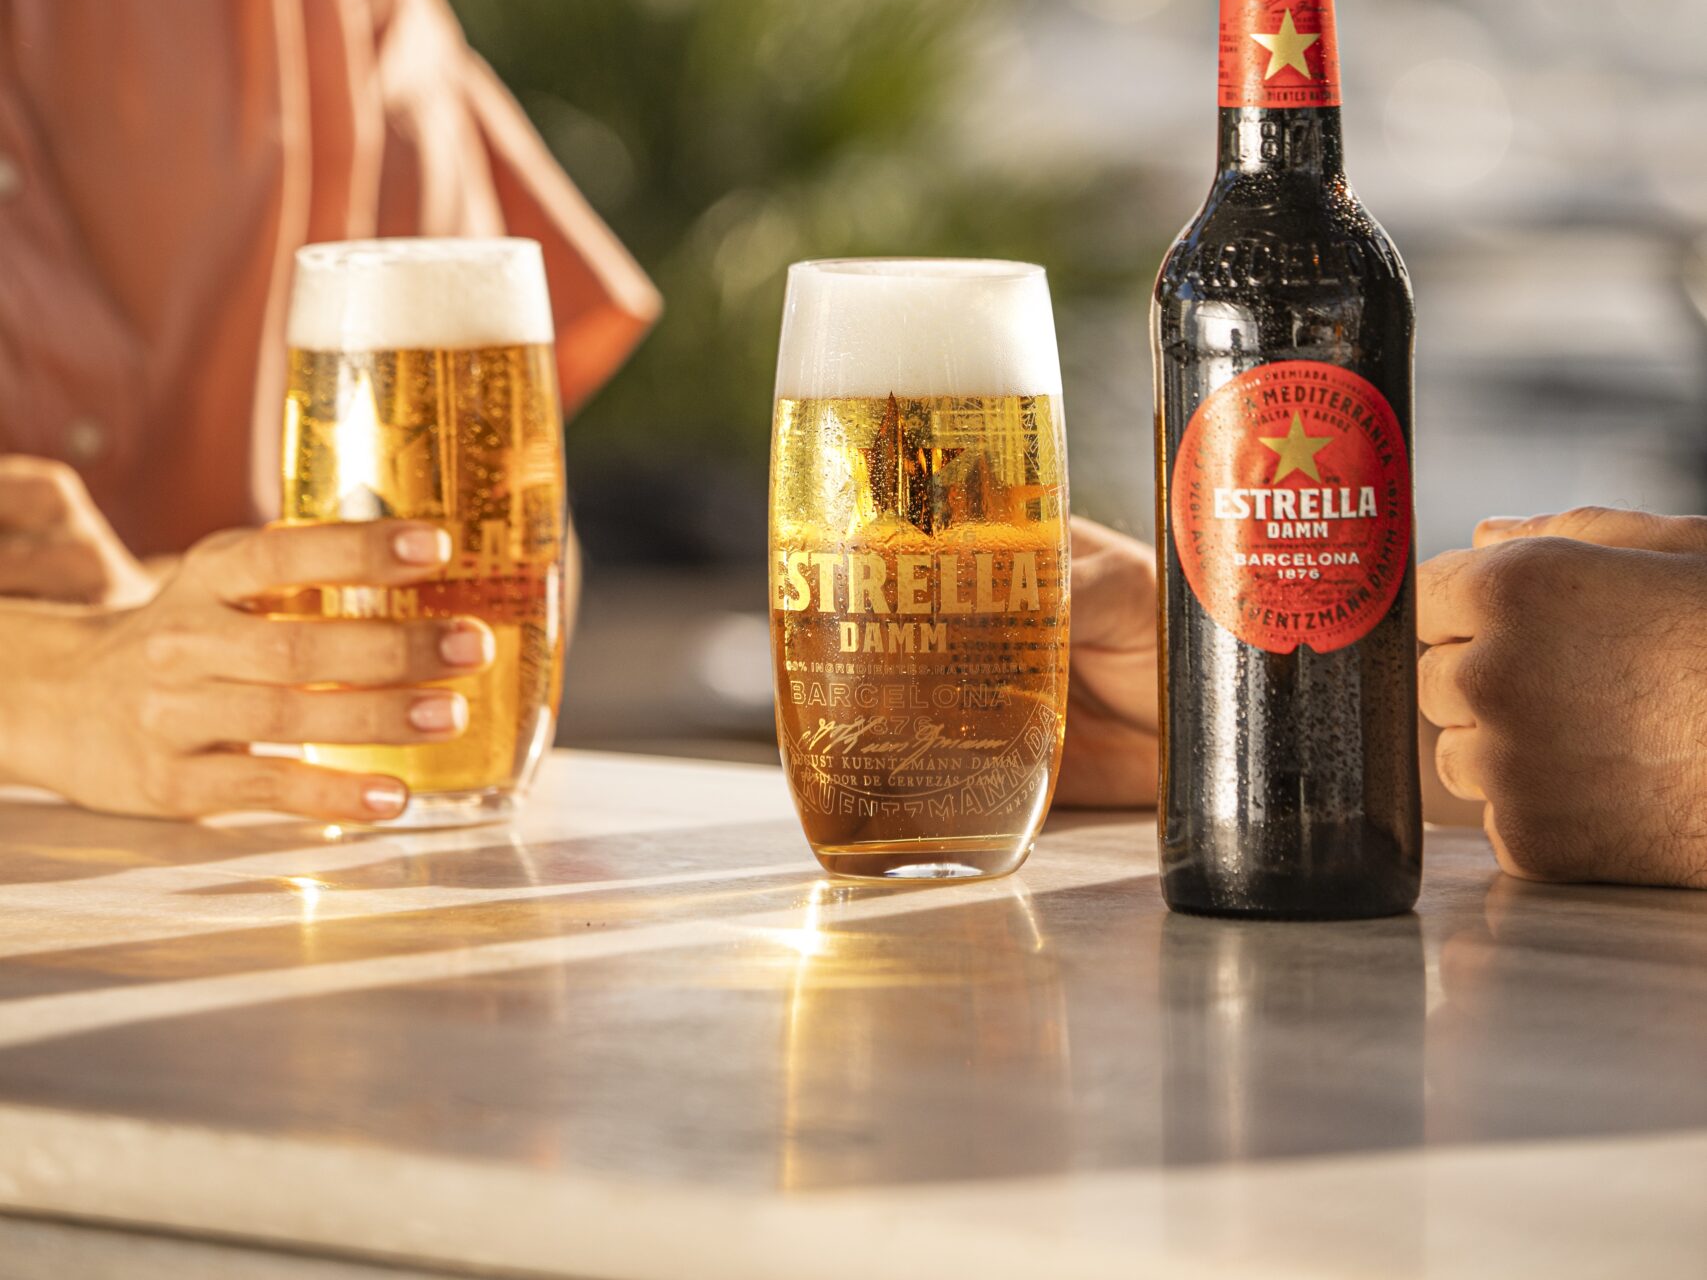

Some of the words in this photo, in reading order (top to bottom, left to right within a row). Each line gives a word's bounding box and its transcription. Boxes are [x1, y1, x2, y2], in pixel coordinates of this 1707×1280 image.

[1213, 486, 1378, 520] ESTRELLA
[1267, 522, 1329, 539] DAMM
[1234, 552, 1360, 566] BARCELONA
[773, 551, 1041, 615] ESTRELLA
[1277, 568, 1320, 580] 1876
[840, 622, 948, 654] DAMM
[790, 681, 1012, 709] BARCELONA
[863, 775, 882, 787] DE
